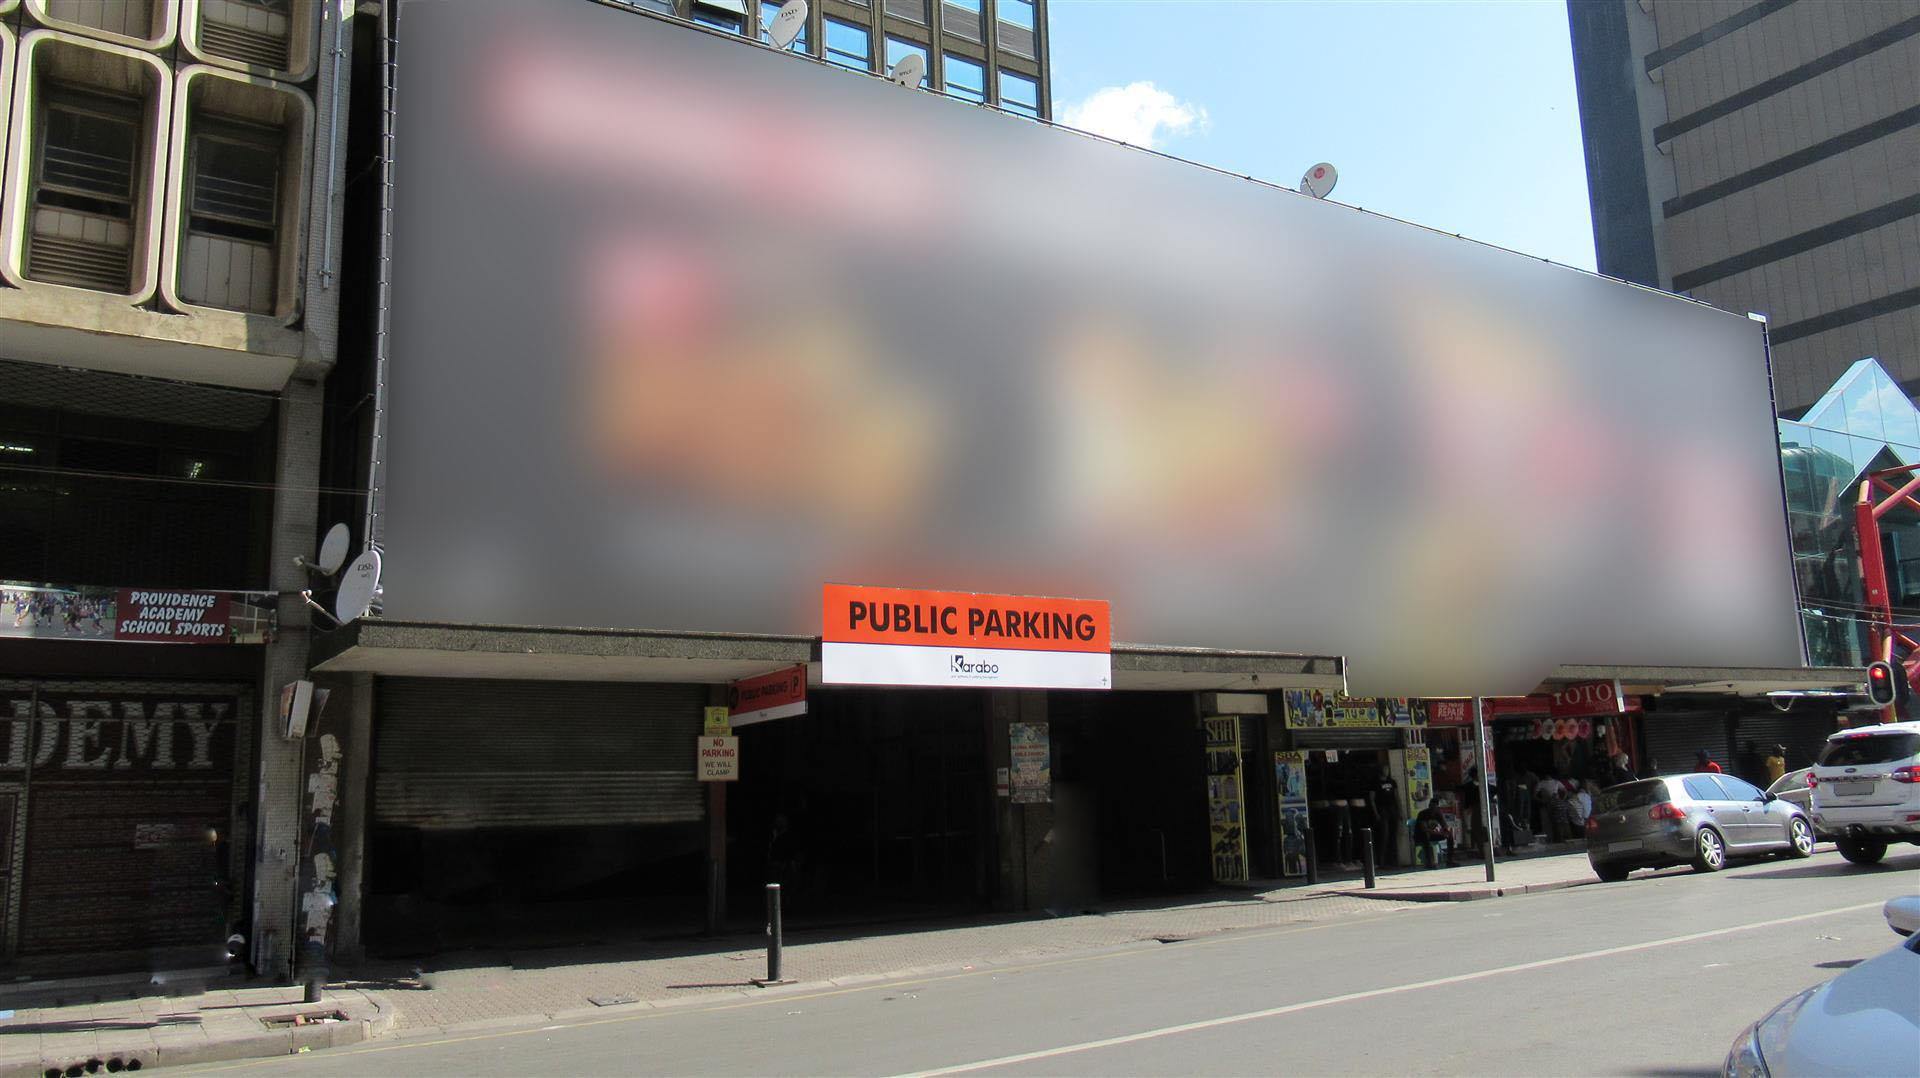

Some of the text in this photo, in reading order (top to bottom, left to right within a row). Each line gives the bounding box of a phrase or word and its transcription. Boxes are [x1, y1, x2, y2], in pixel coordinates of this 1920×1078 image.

[130, 591, 216, 608] PROVIDENCE
[139, 606, 205, 621] ACADEMY
[849, 600, 1096, 642] PUBLIC PARKING
[120, 619, 226, 636] SCHOOL SPORTS
[950, 654, 999, 675] Karabo
[761, 680, 788, 697] PARKING
[1437, 707, 1465, 717] REPAIR
[0, 699, 231, 769] DEMY
[713, 738, 724, 747] NO
[702, 748, 735, 758] PARKING
[706, 768, 730, 776] CLAMP
